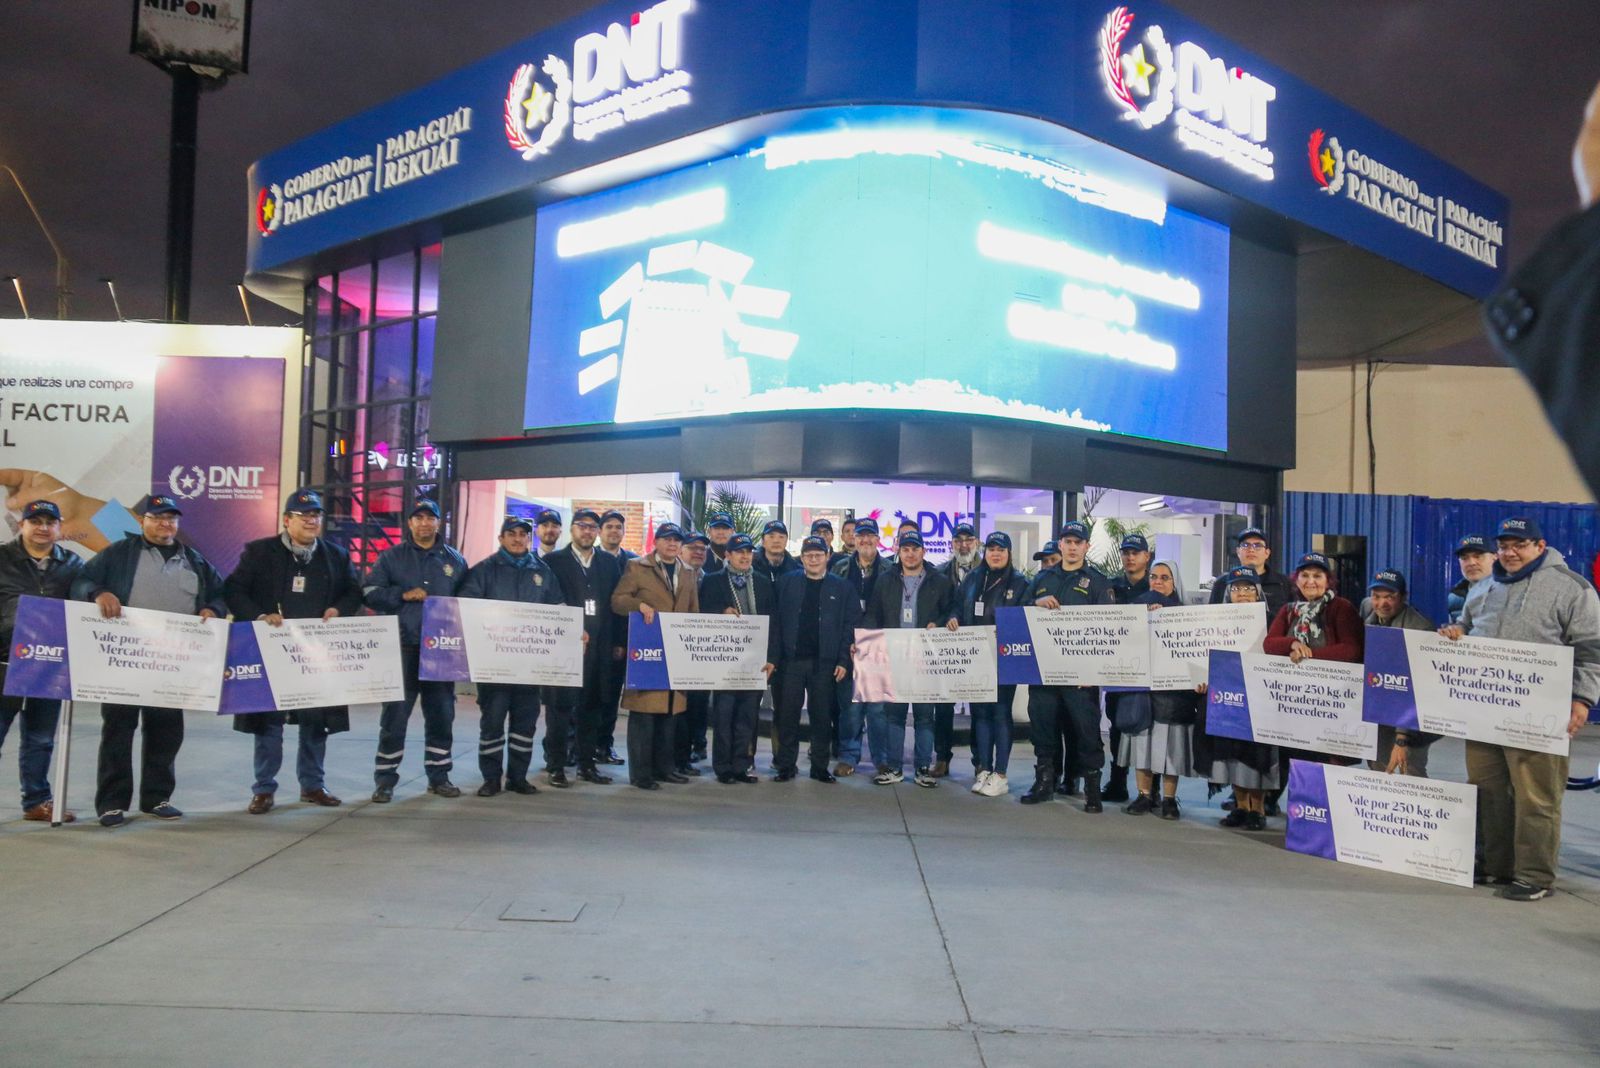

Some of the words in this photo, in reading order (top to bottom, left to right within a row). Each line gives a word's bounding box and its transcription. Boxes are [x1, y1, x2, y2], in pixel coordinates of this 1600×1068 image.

[573, 0, 691, 103] DNIT
[1179, 41, 1276, 143] DNIT
[284, 156, 352, 198] GOBIERNO
[353, 154, 374, 172] DEL
[1347, 149, 1419, 200] GOBIERNO
[1419, 193, 1436, 211] DEL
[283, 171, 373, 225] PARAGUAY
[1346, 173, 1436, 238] PARAGUAY
[65, 380, 86, 388] una
[89, 380, 134, 391] compra
[12, 403, 129, 423] FACTURA
[209, 466, 264, 487] DNIT
[521, 625, 538, 634] 250
[540, 626, 553, 636] kg.
[554, 626, 565, 636] de
[1046, 628, 1065, 636] Vale
[1067, 629, 1081, 638] por
[1104, 627, 1116, 638] kg.
[1118, 627, 1129, 635] de
[1155, 630, 1175, 639] Vale
[1176, 631, 1192, 640] por
[1195, 628, 1215, 637] 250
[1216, 628, 1231, 637] kg.
[1233, 627, 1246, 635] de
[92, 631, 118, 643] Vale
[120, 635, 141, 647] por
[327, 641, 347, 650] 250
[350, 640, 365, 651] kg.
[367, 640, 379, 649] de
[440, 636, 462, 646] DNIT
[545, 638, 557, 646] no
[679, 634, 696, 642] Vale
[698, 636, 711, 644] por
[714, 635, 729, 643] 250
[731, 635, 741, 645] kg.
[743, 635, 752, 643] de
[35, 644, 65, 657] DNIT
[495, 643, 550, 655] Perecederas
[644, 649, 662, 657] DNIT
[956, 647, 968, 657] kg.
[969, 647, 979, 655] de
[1012, 643, 1031, 652] DNIT
[1062, 647, 1115, 656] Perecederas
[1171, 649, 1209, 658] Pereced
[1438, 640, 1470, 648] COMBATE
[1483, 645, 1537, 656] CONTRABANDO
[175, 652, 190, 661] no
[691, 654, 739, 662] Perecederas
[1420, 645, 1456, 655] DONACIÓN
[1468, 651, 1510, 661] PRODUCTOS
[1511, 656, 1558, 667] INCAUTADOS
[108, 657, 180, 673] Perecederas
[236, 664, 262, 674] DNIT
[1269, 661, 1295, 669] COMBATE
[1306, 665, 1350, 674] CONTRABANDO
[1253, 666, 1283, 674] DONACIÓN
[1293, 670, 1328, 679] PRODUCTOS
[1329, 675, 1363, 683] INCAUTADO
[1383, 674, 1409, 685] DNIT
[1432, 660, 1456, 673] Vale
[1458, 665, 1479, 678] por
[1480, 666, 1505, 679] 250
[1507, 669, 1526, 685] kg.
[1528, 673, 1544, 685] de
[1263, 679, 1283, 690] Vale
[1285, 682, 1302, 693] por
[1304, 684, 1325, 695] 250
[1327, 686, 1342, 699] kg.
[1344, 688, 1357, 699] de
[1439, 674, 1511, 693] Mercaderías
[1515, 686, 1530, 696] no
[1223, 691, 1244, 702] DNIT
[1449, 687, 1521, 708] Perecederas
[1278, 703, 1339, 719] Perecederas
[1333, 701, 1346, 709] no
[1354, 775, 1382, 785] COMBATE
[1394, 781, 1444, 793] CONTRABANDO
[1337, 779, 1369, 789] DONACIÓN
[1380, 786, 1418, 797] PRODUCTOS
[1420, 792, 1463, 804] INCAUTADOS
[1305, 805, 1327, 818] DNIT
[1348, 793, 1369, 806] Vale
[1371, 798, 1390, 812] por
[1392, 801, 1414, 814] 250
[1416, 805, 1433, 820] kg.
[1435, 808, 1450, 820] de
[1354, 807, 1421, 827] Mercaderías
[1423, 820, 1438, 830] no
[1363, 820, 1430, 841] Perecederas
